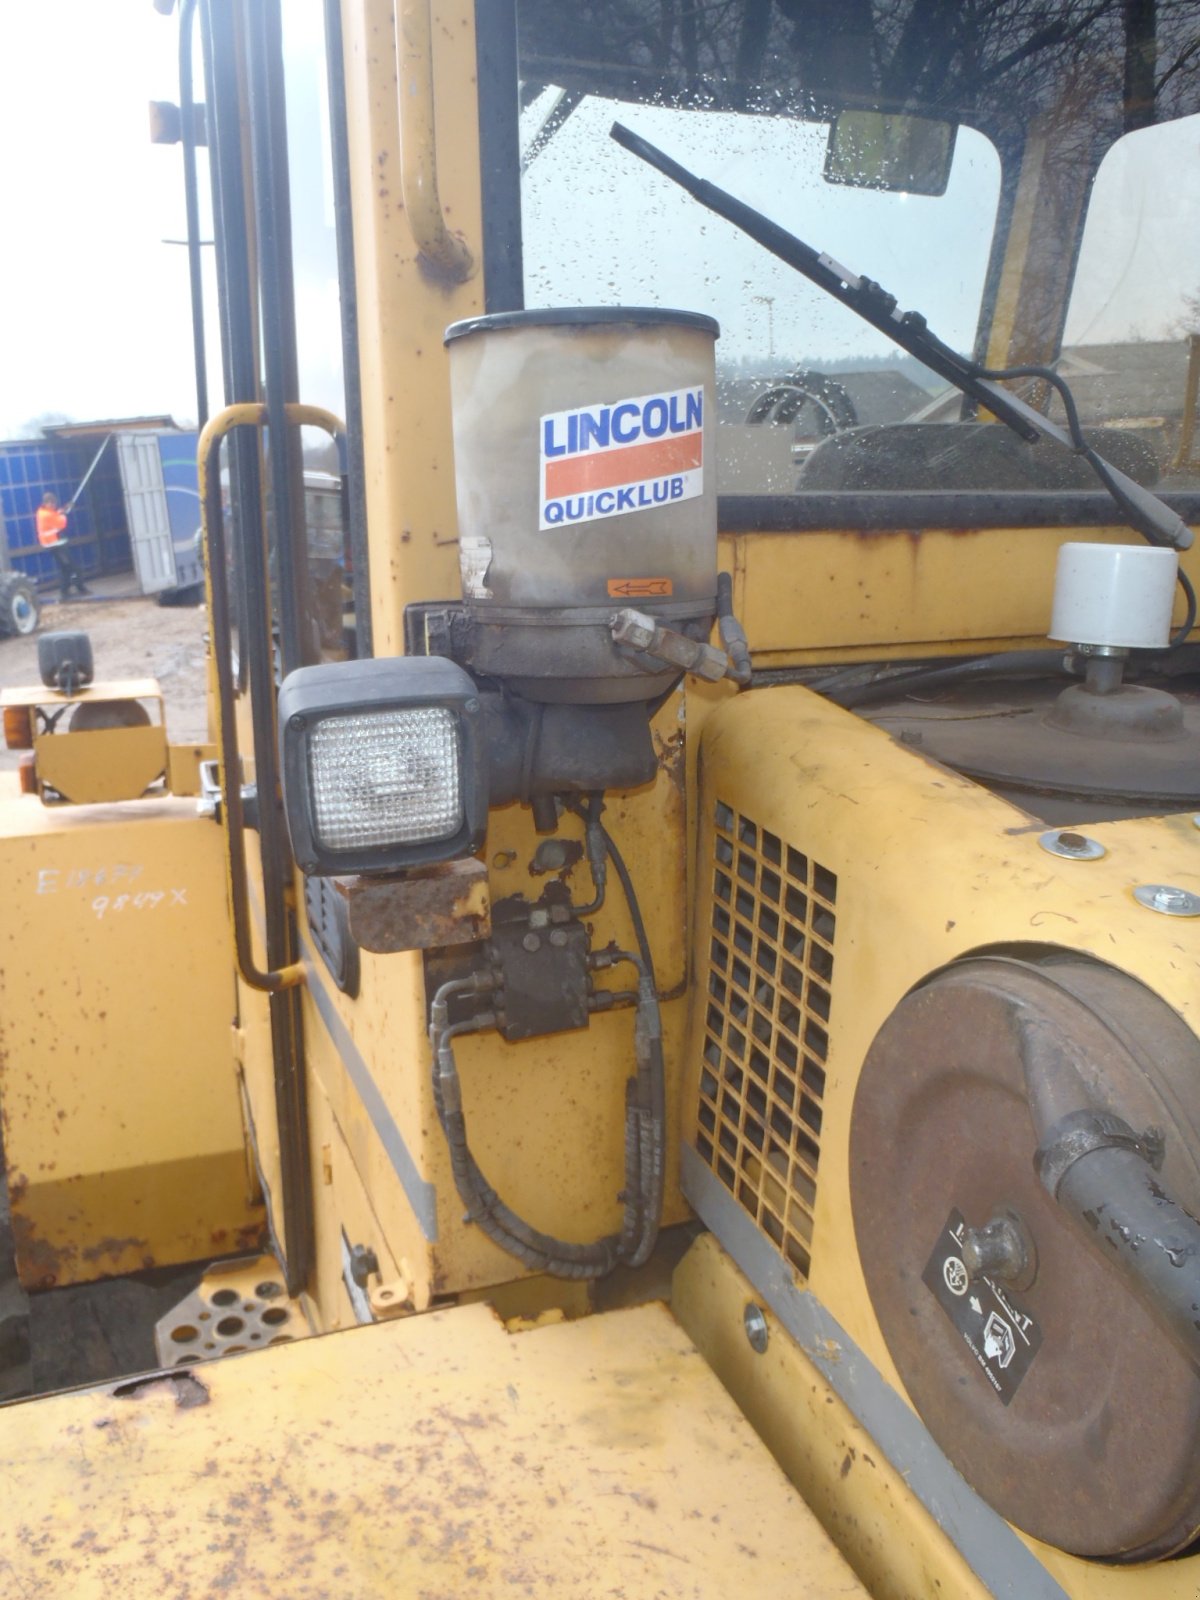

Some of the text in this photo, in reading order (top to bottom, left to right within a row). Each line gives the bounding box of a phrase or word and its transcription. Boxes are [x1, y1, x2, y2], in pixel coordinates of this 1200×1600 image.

[544, 390, 703, 458] LINCOLN
[544, 477, 684, 524] QUICKLUB
[962, 1331, 980, 1356] VOLVO
